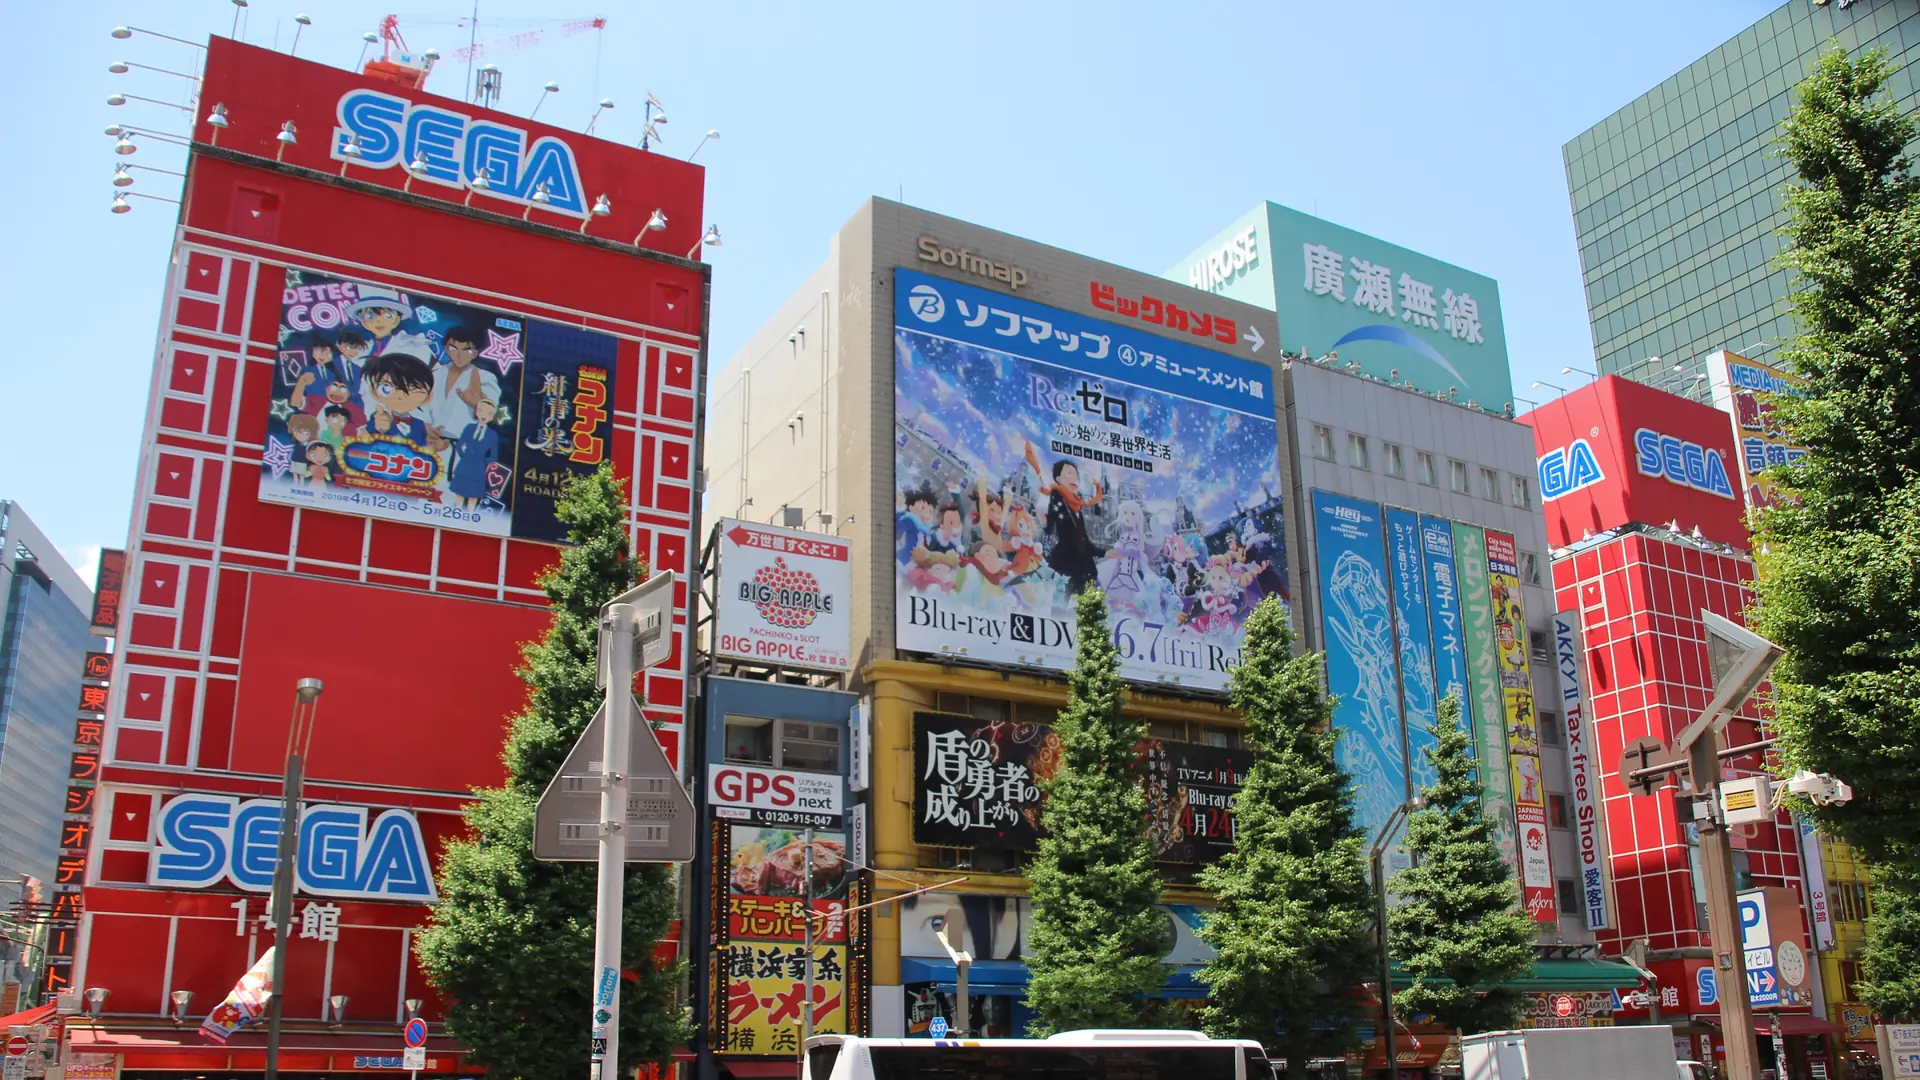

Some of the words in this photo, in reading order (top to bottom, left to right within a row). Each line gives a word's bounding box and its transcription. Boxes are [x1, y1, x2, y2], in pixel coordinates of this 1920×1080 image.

[331, 88, 589, 218] SEGA
[917, 235, 1028, 290] Sofmap
[1188, 225, 1258, 291] HIROSE
[1090, 281, 1237, 345] ビックカメラ
[1303, 243, 1485, 345] 廣瀬無線
[496, 317, 522, 332] SEGA
[956, 298, 1110, 359] ソフマップ
[569, 376, 608, 465] コナン
[1030, 374, 1128, 427] Re:ゼロ
[1056, 422, 1172, 461] から始める異世界生活
[364, 452, 433, 480] コナン
[1633, 427, 1736, 501] SEGA
[1334, 505, 1361, 524] Hey
[740, 582, 773, 603] BIG
[779, 590, 833, 613] APPLE
[749, 626, 793, 641] PACHINKO
[800, 634, 821, 645] SLOT
[908, 594, 1006, 645] Blu-ray
[721, 635, 752, 653] BIG
[798, 778, 834, 789] リアルタイム
[924, 729, 1040, 802] 盾の勇者の
[1177, 768, 1213, 781] TVアニメ
[1566, 703, 1588, 802] Tax-free
[1577, 804, 1597, 866] Shop
[714, 769, 796, 807] GPS
[798, 797, 832, 810] next
[924, 783, 1019, 832] 成り上がり
[765, 811, 832, 826] 0120-915-047
[1517, 806, 1544, 816] JAPANESE
[47, 687, 108, 992] 東京ラジオデパート
[150, 793, 439, 901] SEGA
[827, 902, 844, 938] 2F
[1739, 900, 1761, 944] P
[1812, 891, 1827, 923] 3号館
[728, 945, 842, 982] 横浜家系
[728, 980, 843, 1026] ラーメン
[931, 1022, 945, 1034] 437
